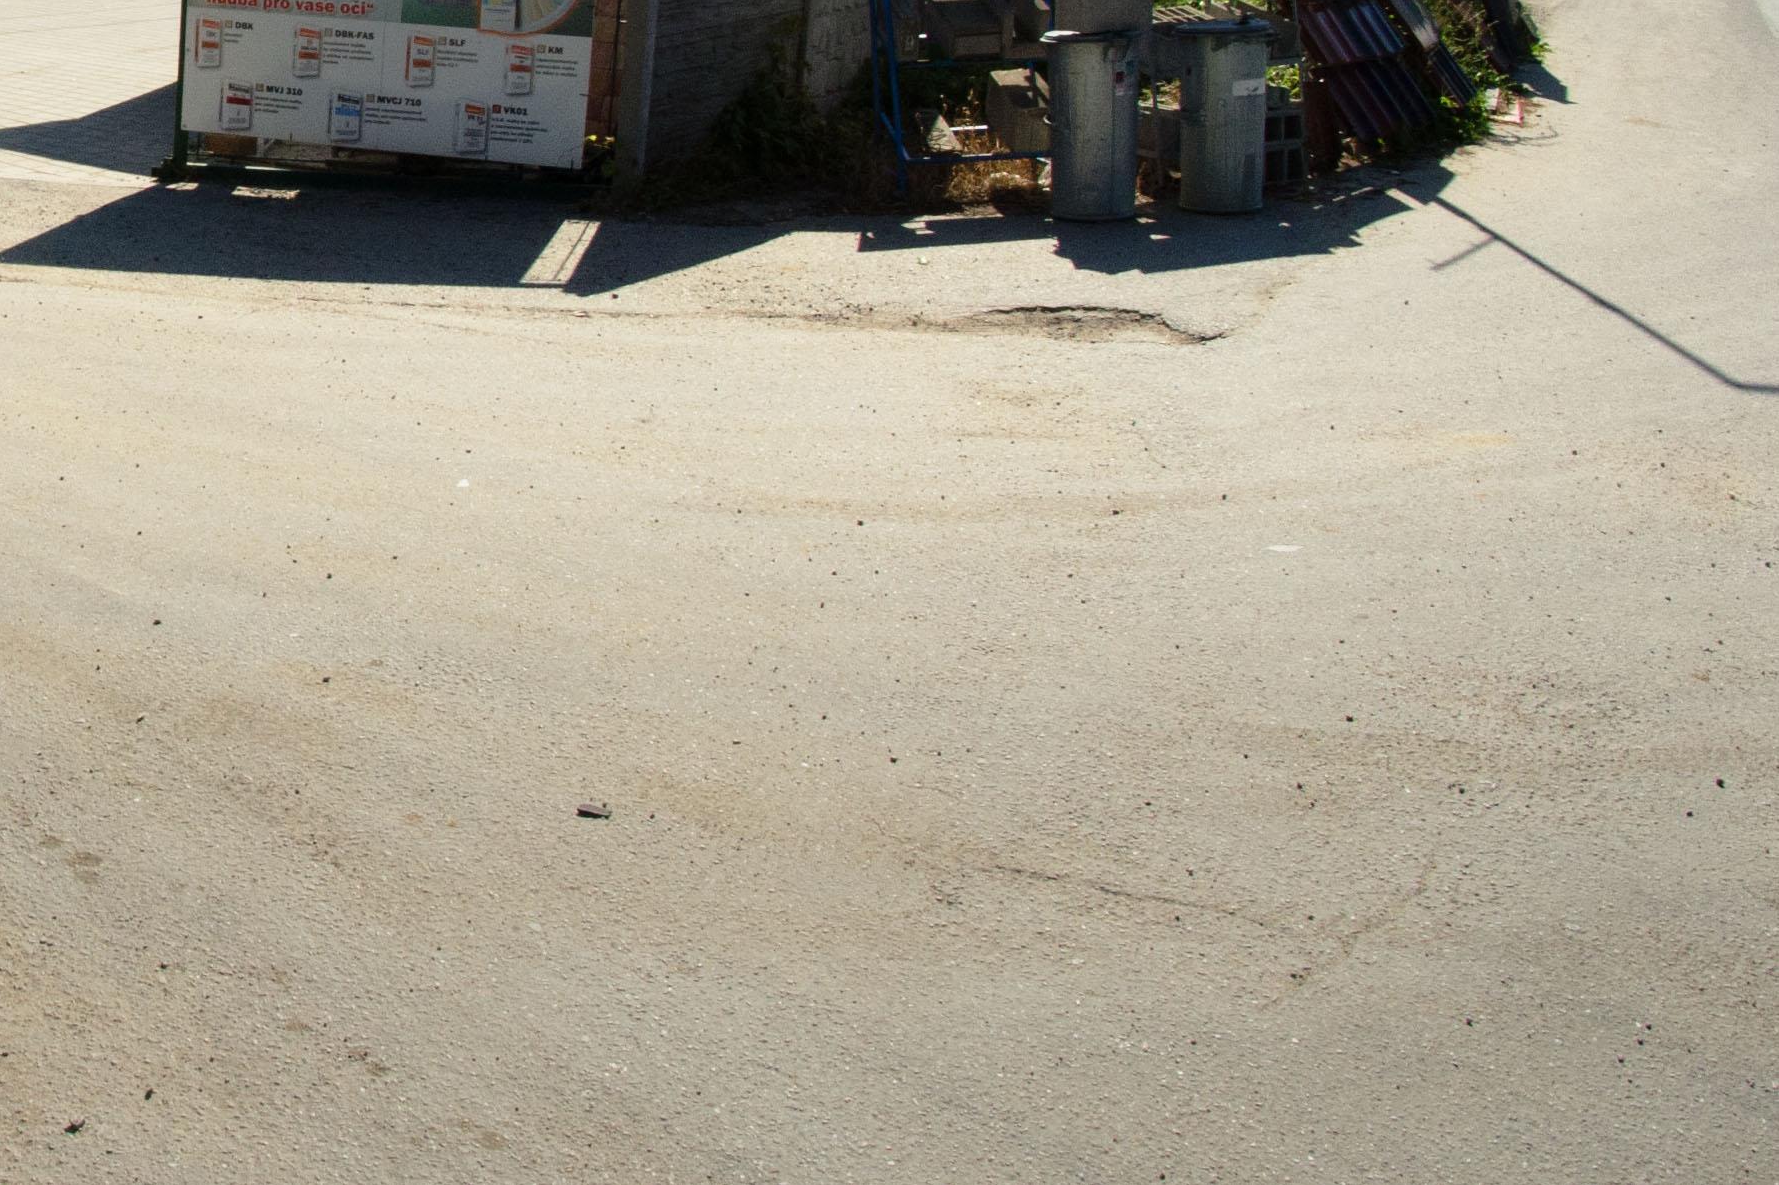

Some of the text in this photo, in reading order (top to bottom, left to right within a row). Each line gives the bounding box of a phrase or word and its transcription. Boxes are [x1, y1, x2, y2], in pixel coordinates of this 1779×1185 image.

[234, 21, 253, 31] DBK
[334, 28, 375, 41] DBK-FAS
[448, 38, 466, 48] SLF
[547, 46, 564, 56] KM
[265, 85, 303, 97] MVJ 310
[376, 95, 422, 107] MVCJ 710
